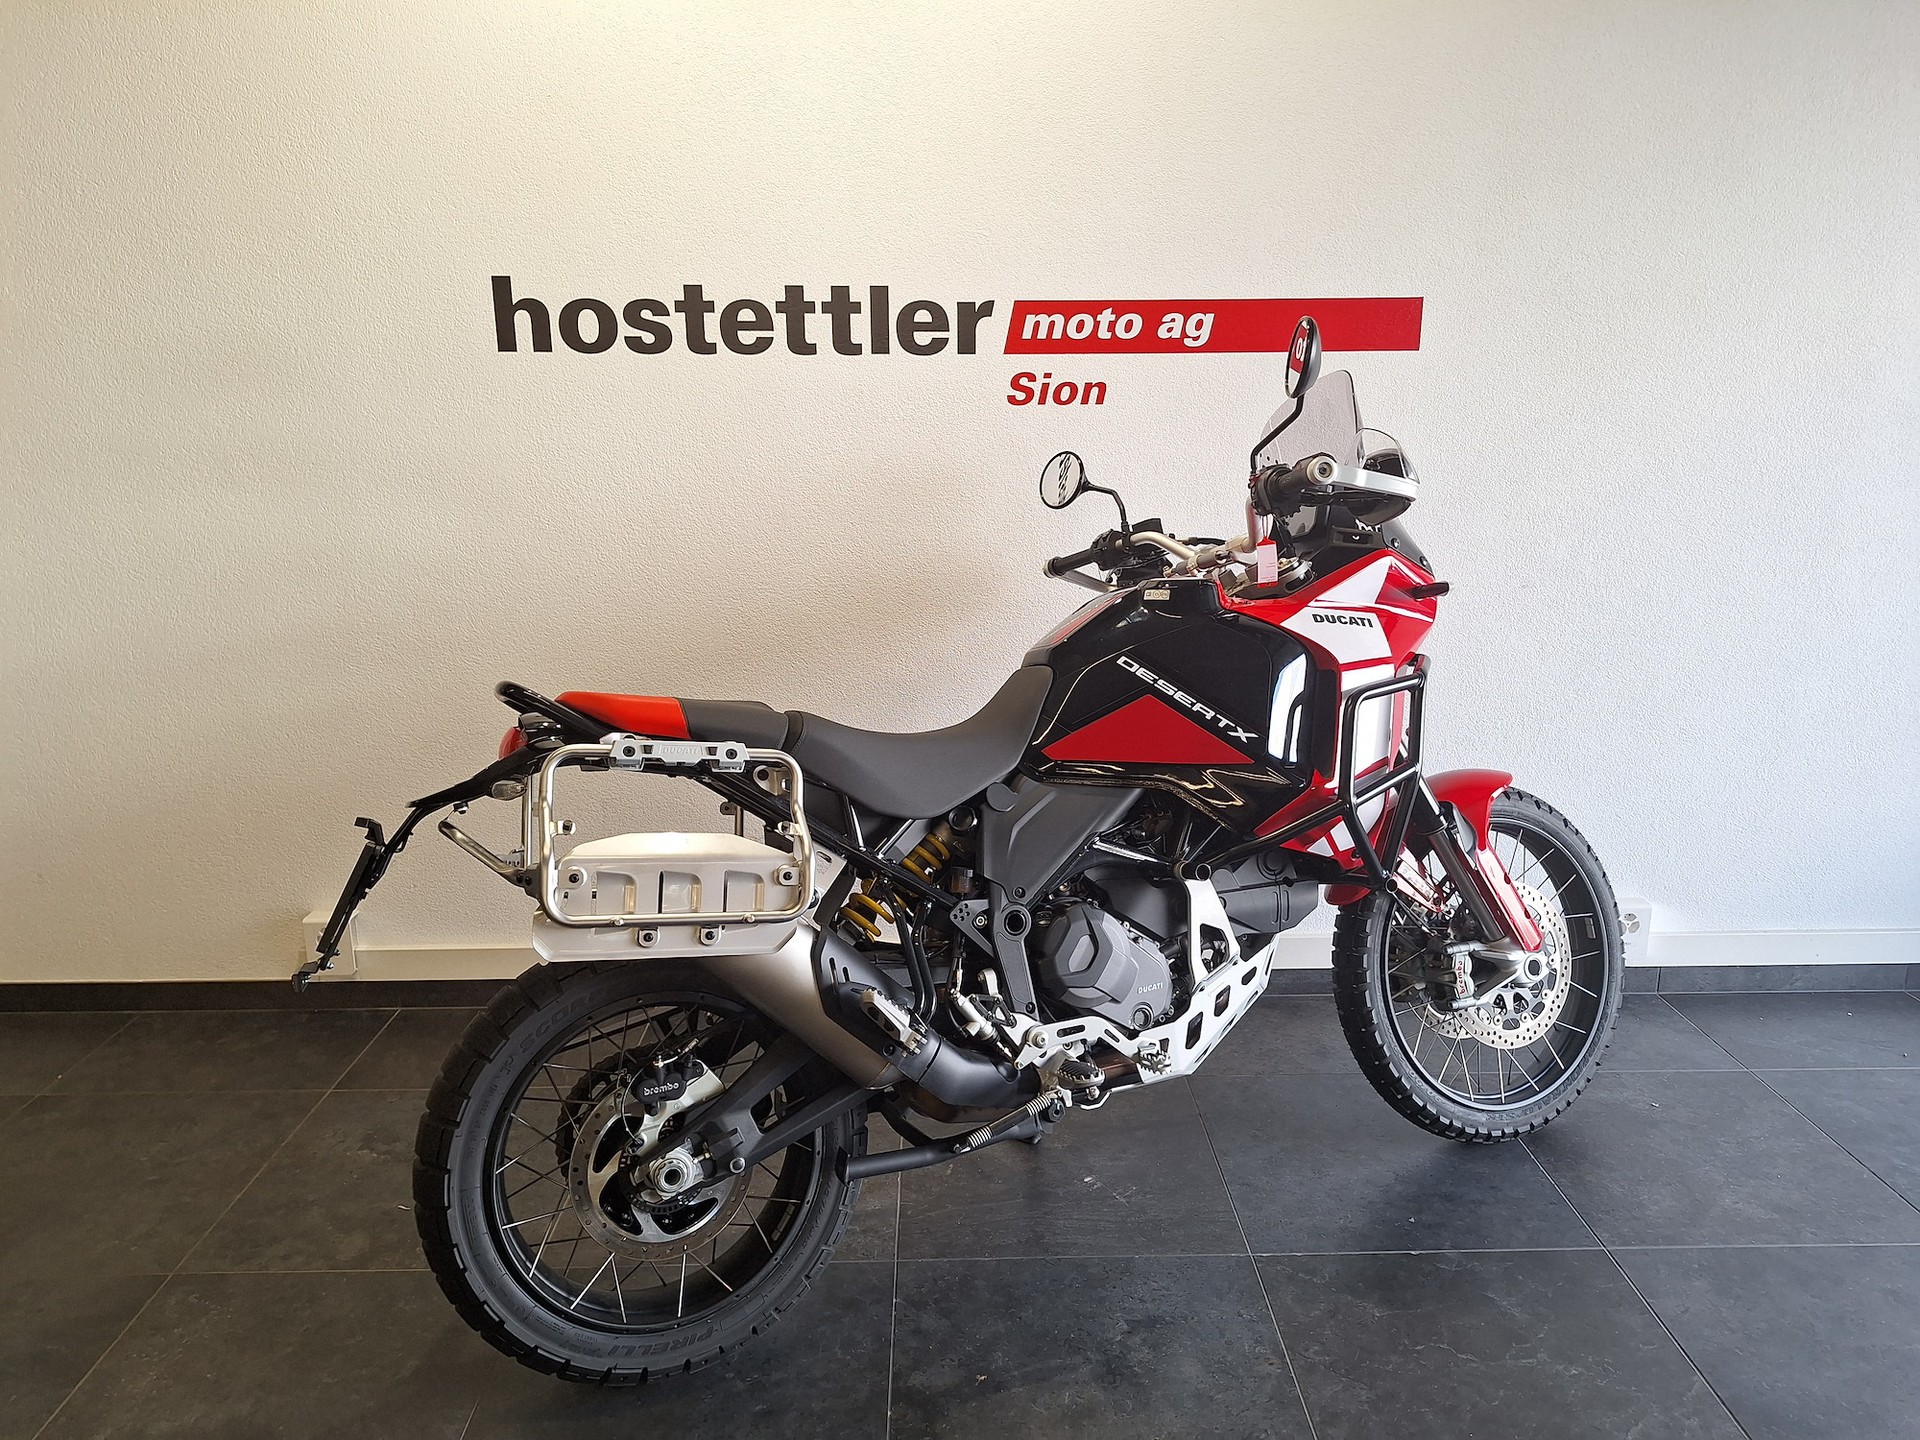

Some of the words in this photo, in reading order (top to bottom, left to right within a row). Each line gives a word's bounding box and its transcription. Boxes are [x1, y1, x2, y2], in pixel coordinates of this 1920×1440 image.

[491, 275, 995, 356] hostettler
[1021, 308, 1143, 340] moto
[1156, 311, 1215, 348] ag
[1006, 371, 1108, 406] Sion
[1312, 613, 1374, 628] DUCATI
[1116, 655, 1260, 744] DESERTX
[662, 744, 701, 755] DUCATI
[1138, 982, 1164, 994] DUCATI
[1455, 960, 1466, 995] brembo
[643, 1081, 680, 1097] brembo
[607, 1325, 714, 1357] PIRELLI
